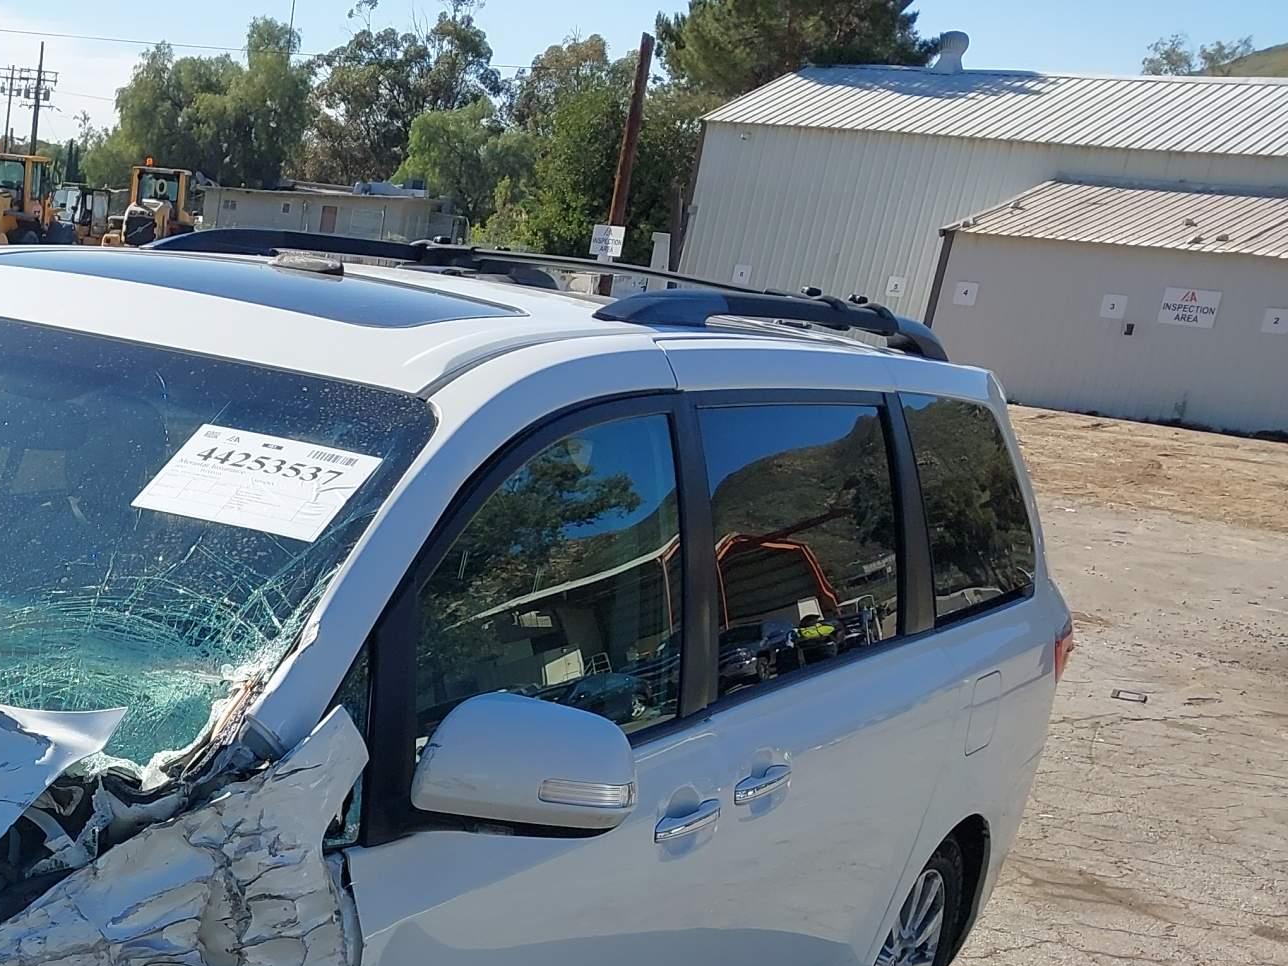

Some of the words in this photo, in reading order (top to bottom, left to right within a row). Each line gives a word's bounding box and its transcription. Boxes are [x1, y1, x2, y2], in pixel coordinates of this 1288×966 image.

[593, 238, 622, 246] INSPECTION
[1162, 303, 1216, 316] INSPECTION
[1173, 314, 1199, 323] AREA
[1272, 317, 1280, 325] 2
[197, 447, 343, 485] 44253537
